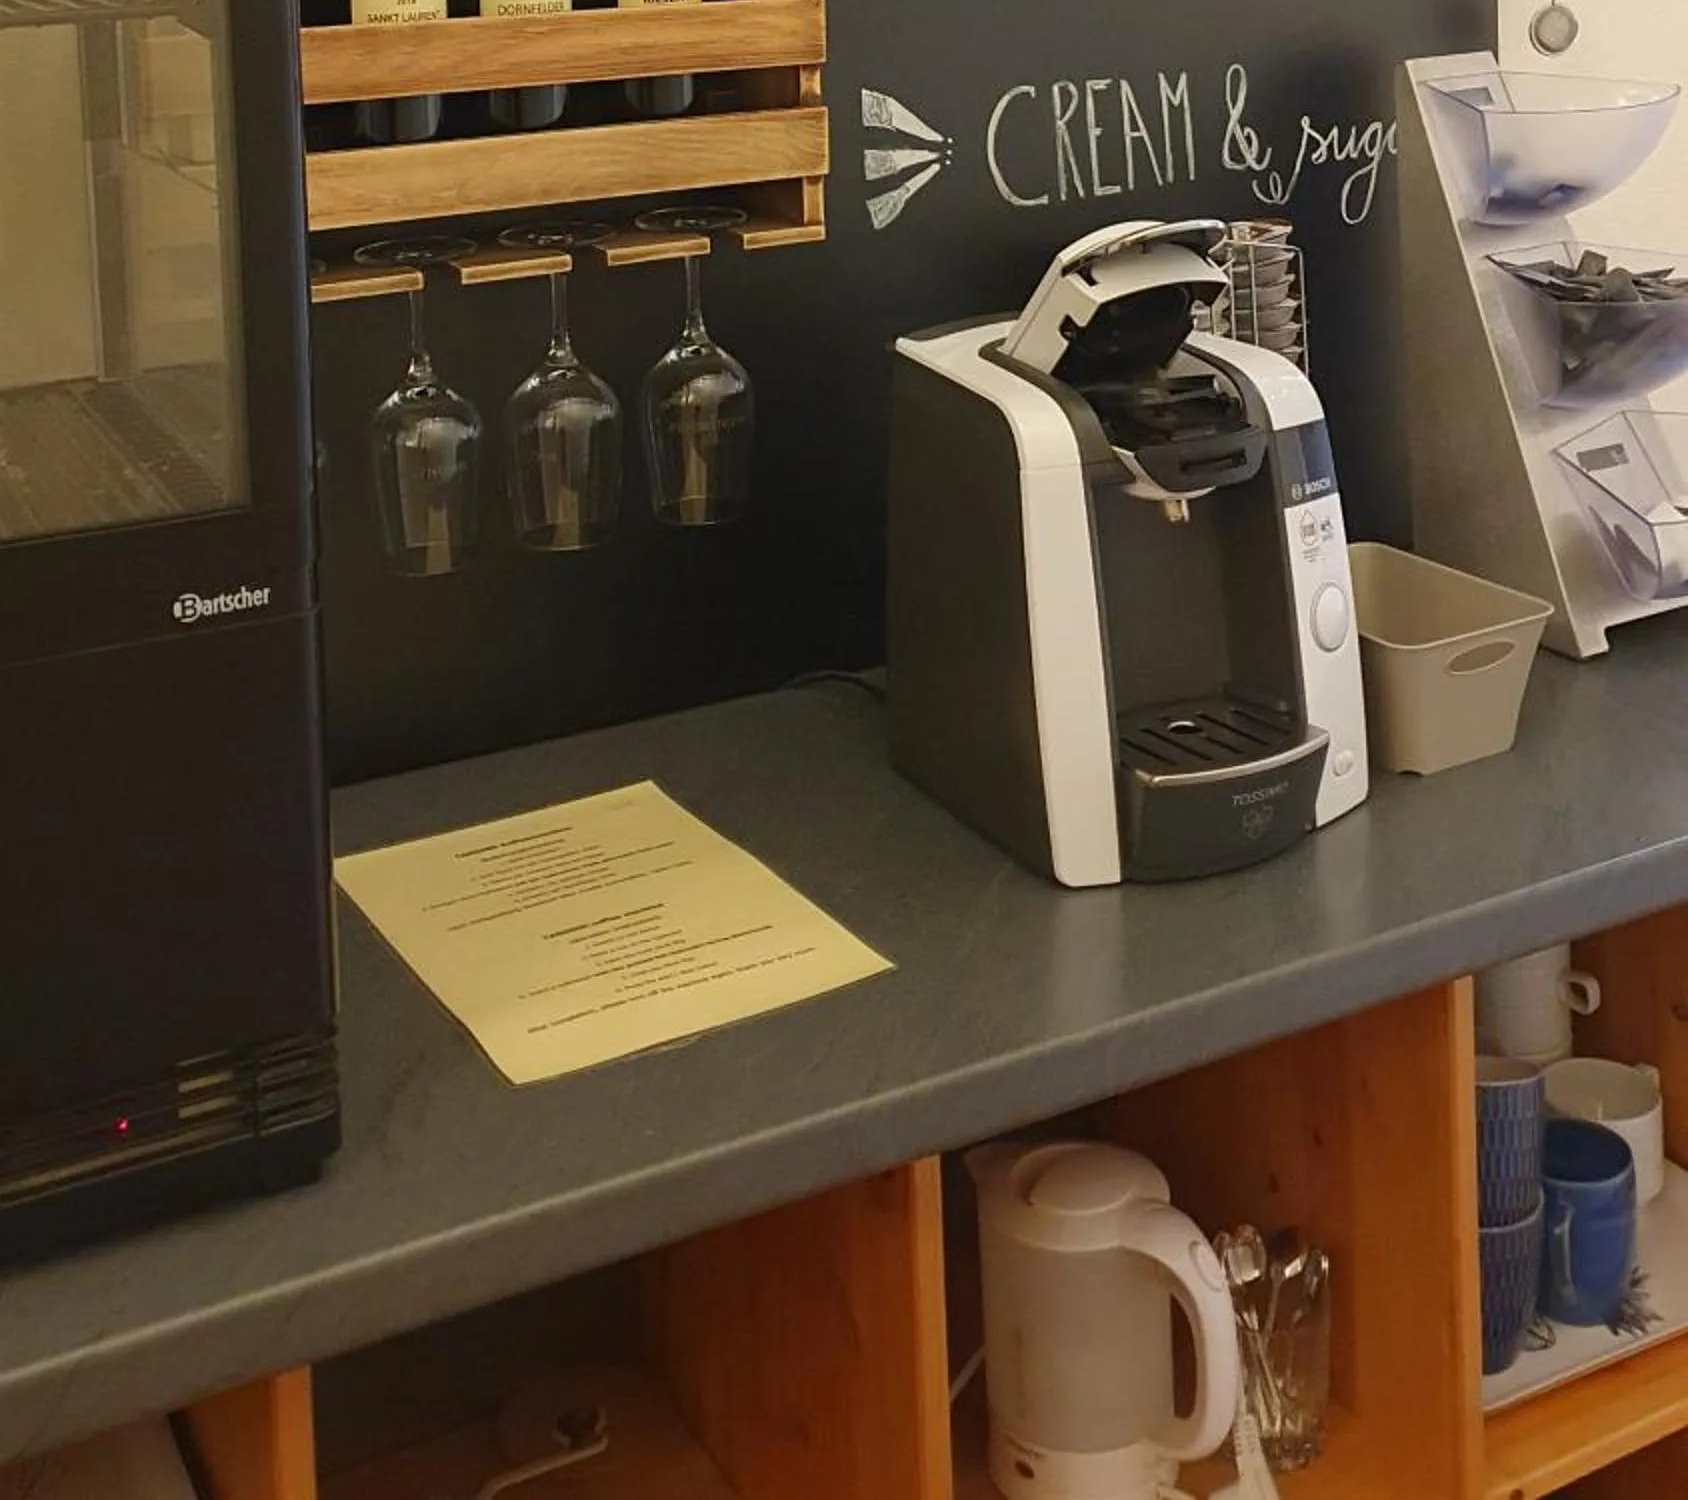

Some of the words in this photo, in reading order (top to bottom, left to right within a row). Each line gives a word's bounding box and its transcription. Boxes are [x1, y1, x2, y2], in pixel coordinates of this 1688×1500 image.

[496, 1, 565, 17] DORNFELDER
[986, 71, 1196, 206] CREAM
[173, 585, 271, 623] Bartscher
